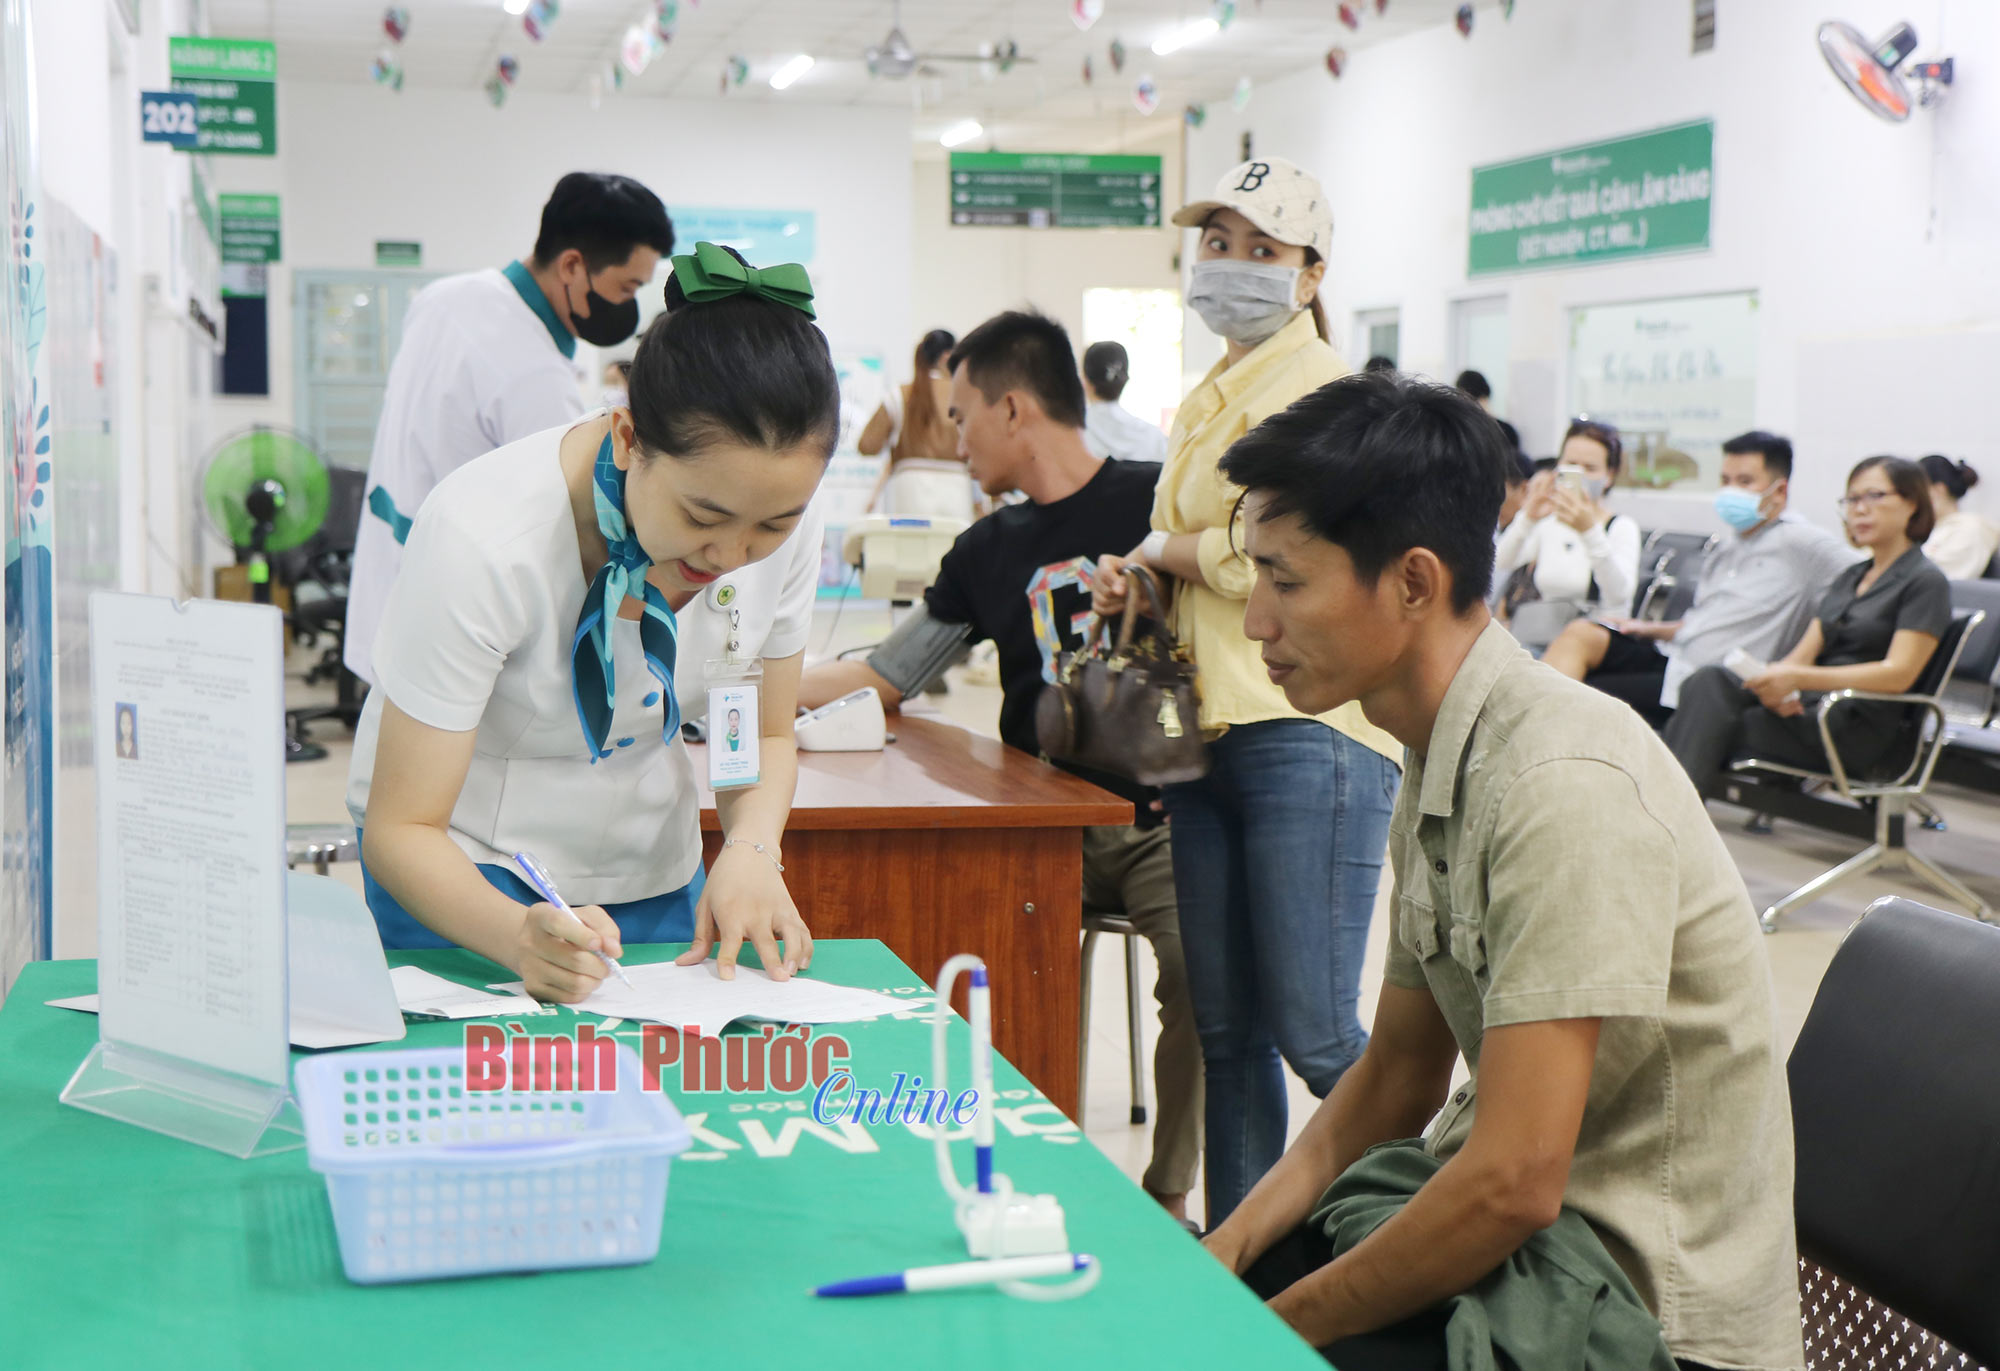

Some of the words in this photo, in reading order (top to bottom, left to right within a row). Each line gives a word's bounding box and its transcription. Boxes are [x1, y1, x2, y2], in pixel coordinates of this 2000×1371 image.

[144, 101, 198, 134] 202
[1234, 162, 1270, 192] B
[1568, 180, 1598, 220] QUẢ
[1632, 171, 1665, 210] LÂM
